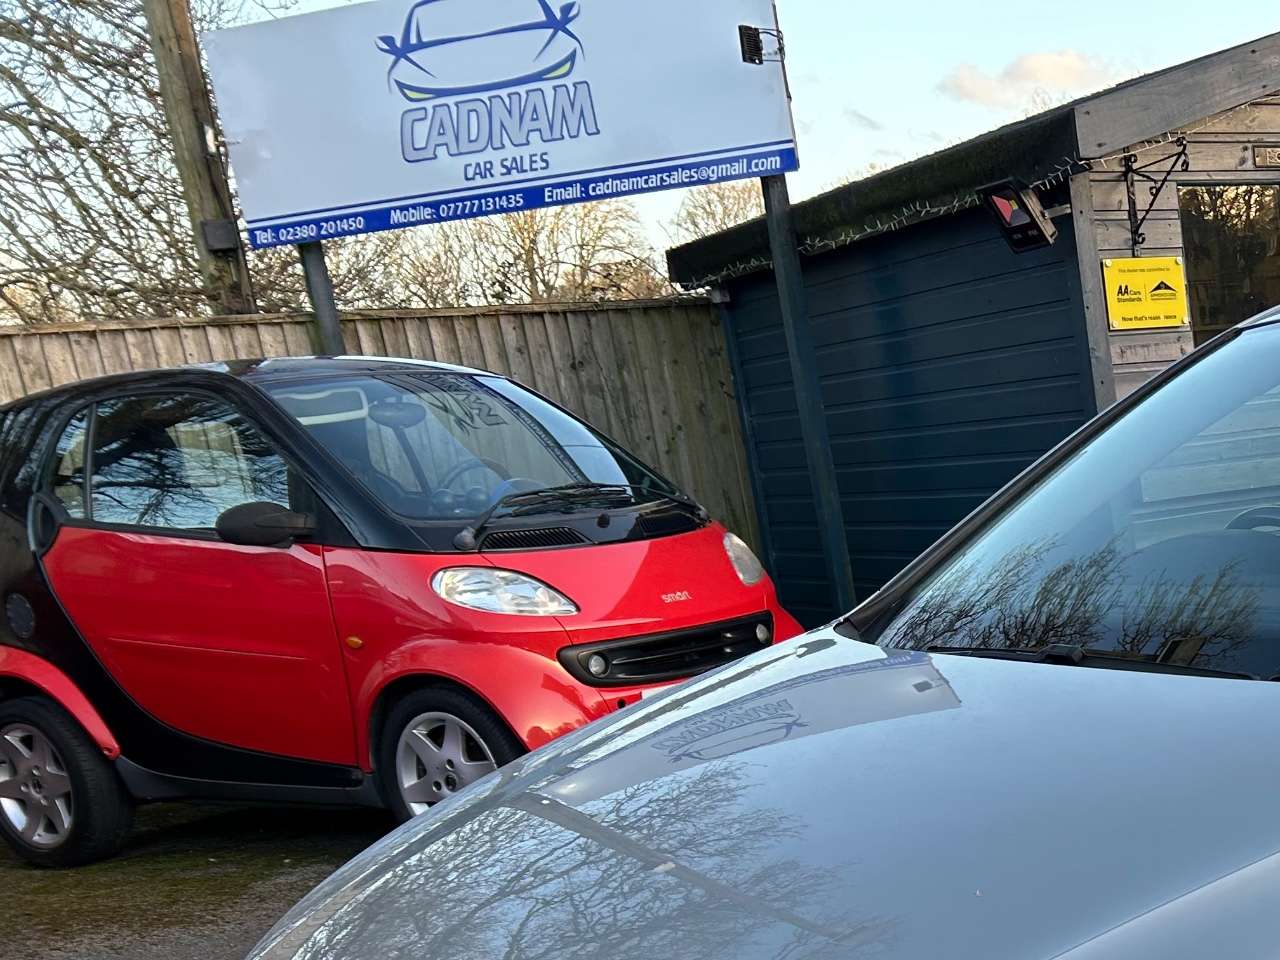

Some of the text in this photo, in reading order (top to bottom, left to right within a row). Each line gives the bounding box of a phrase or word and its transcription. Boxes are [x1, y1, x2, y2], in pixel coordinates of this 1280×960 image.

[401, 80, 600, 163] CADNAM
[464, 152, 550, 181] CAR SALES
[254, 155, 781, 245] Tel: 02380 201450 Mobile: 07777131435 Email: cadnamcarsales@gmail.com
[1117, 284, 1129, 296] AA
